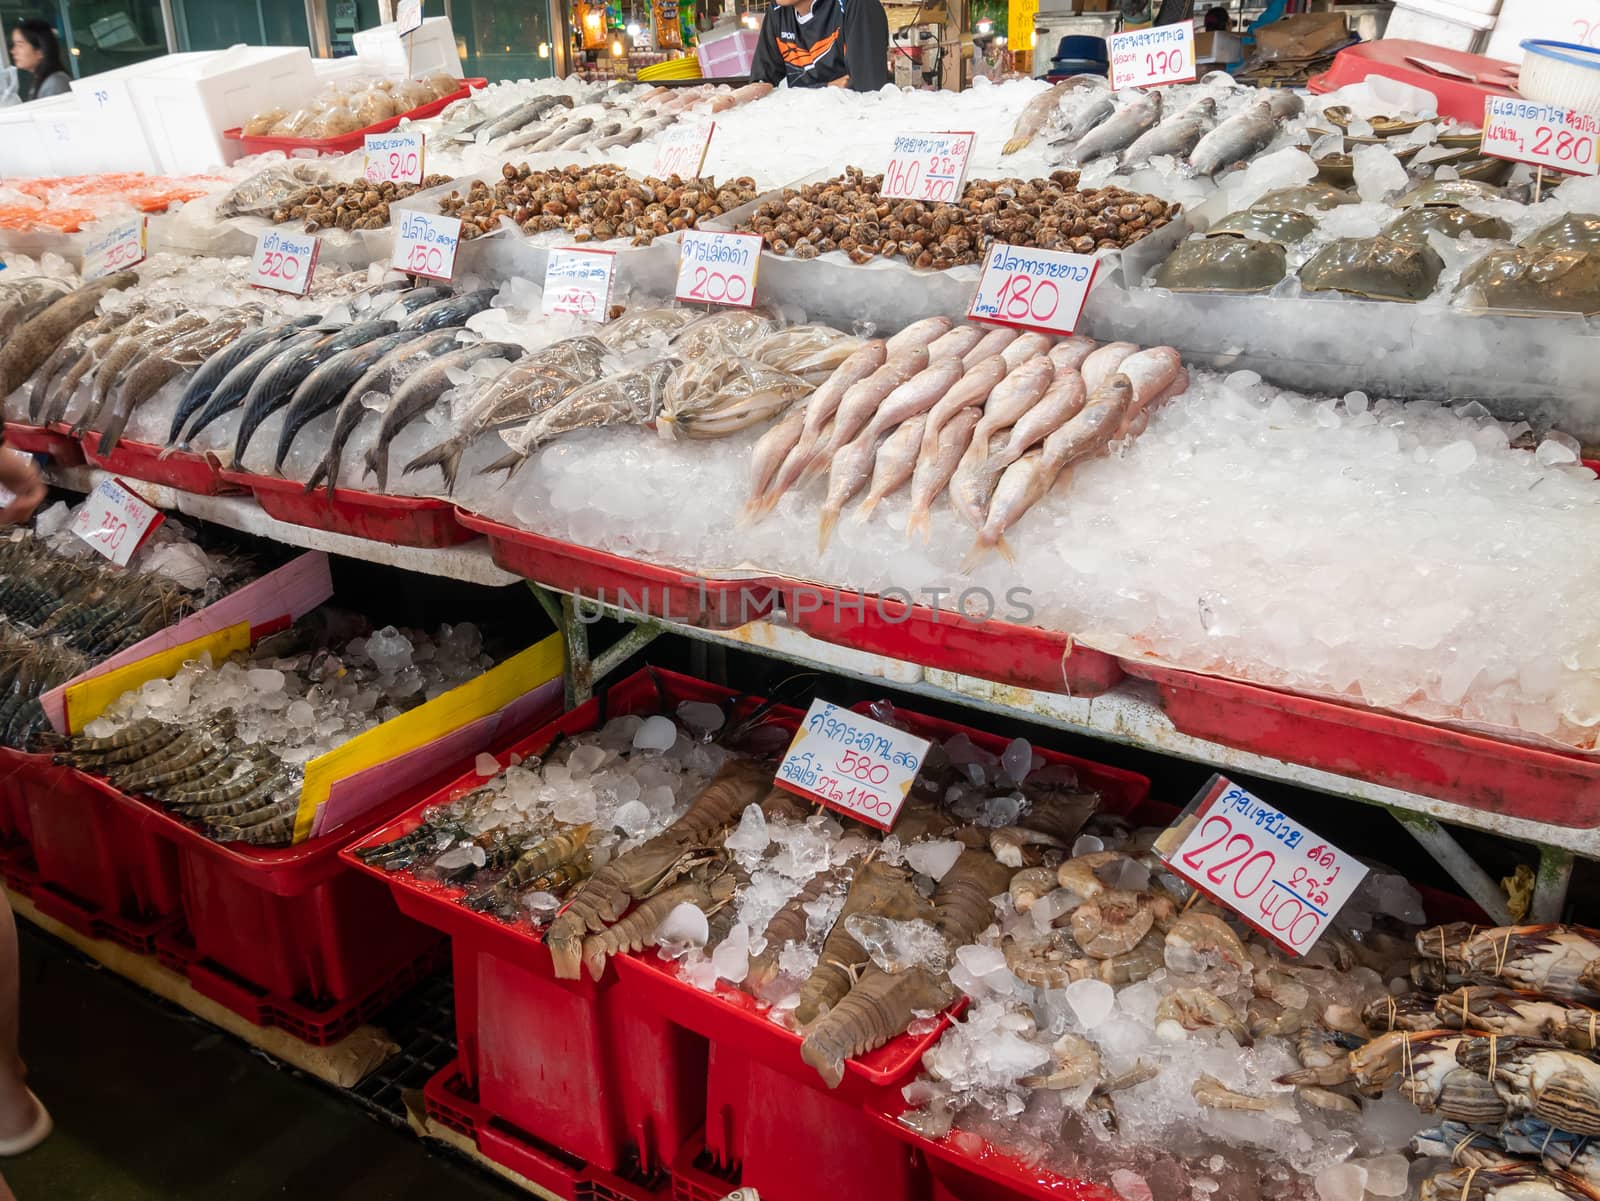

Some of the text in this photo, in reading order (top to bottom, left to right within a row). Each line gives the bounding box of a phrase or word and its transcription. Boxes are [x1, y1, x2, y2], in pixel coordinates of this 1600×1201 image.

[1146, 48, 1183, 77] 170
[1531, 126, 1592, 165] 280
[389, 153, 417, 178] 240
[885, 159, 920, 195] 160
[919, 179, 954, 201] 300
[257, 252, 299, 280] 320
[407, 244, 442, 273] 150
[992, 246, 1089, 282] ปลาทรายขาว
[689, 266, 746, 302] 200
[990, 274, 1059, 321] 180
[835, 749, 889, 785] 580
[846, 786, 892, 817] 1,100
[1182, 815, 1276, 899] 220
[1259, 885, 1320, 946] 400
